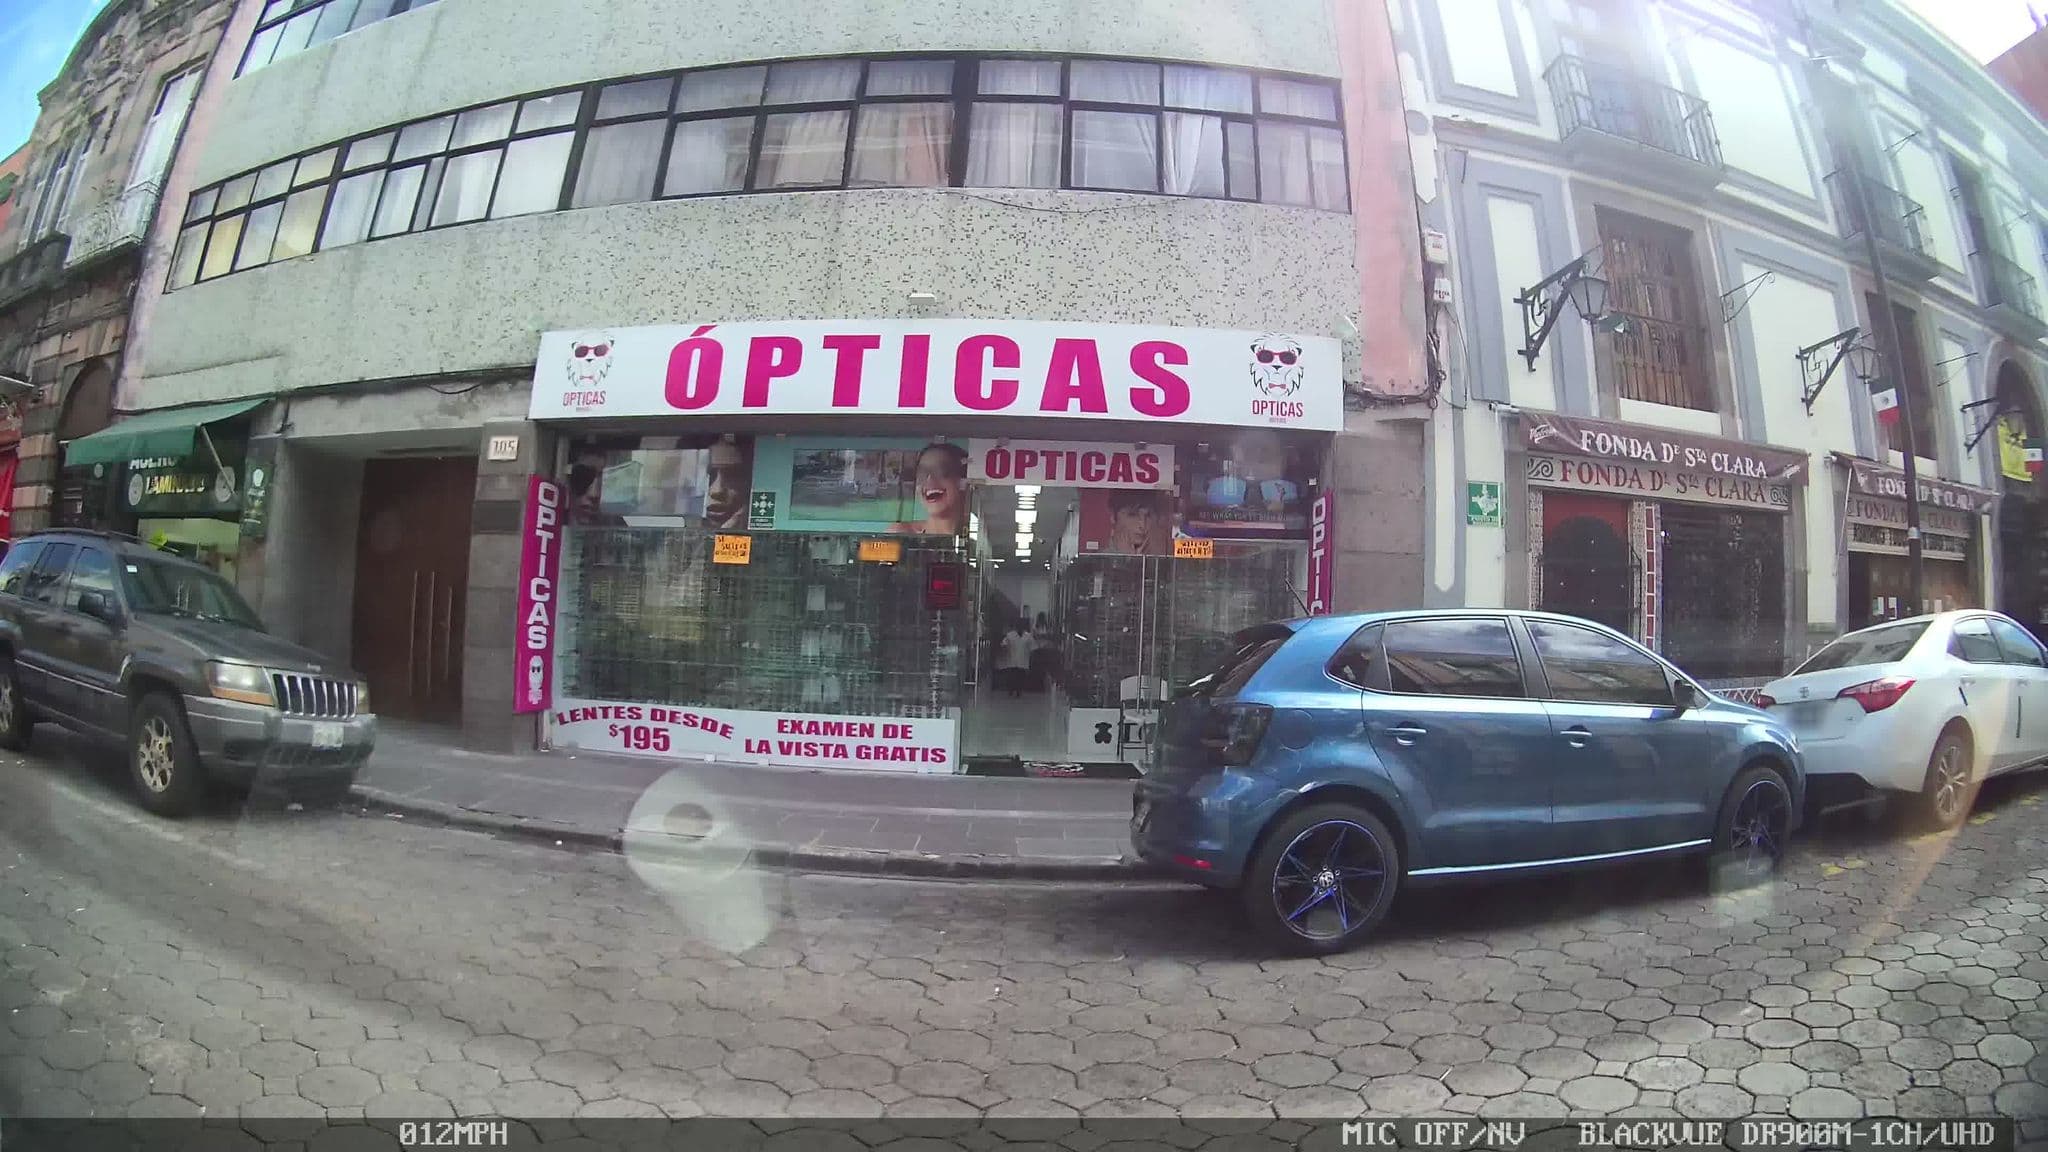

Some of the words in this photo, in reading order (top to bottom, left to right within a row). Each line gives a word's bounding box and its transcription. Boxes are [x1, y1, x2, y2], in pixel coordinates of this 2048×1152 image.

[664, 325, 1190, 417] ÓPTICAS
[562, 390, 607, 407] OPTICAS
[1252, 399, 1304, 418] OPTICAS
[1580, 429, 1658, 462] FONDA
[1711, 452, 1768, 479] CLARA
[1560, 460, 1645, 490] FONDA
[1705, 476, 1767, 504] CLARA
[527, 481, 559, 649] OPTICAS
[556, 705, 643, 726] LENTES
[650, 707, 735, 740] DESDE
[609, 722, 671, 752] $195
[777, 718, 875, 739] EXAMEN
[882, 721, 914, 740] DE
[744, 738, 772, 755] LA
[778, 740, 849, 760] VISTA
[855, 744, 947, 764] GRATIS
